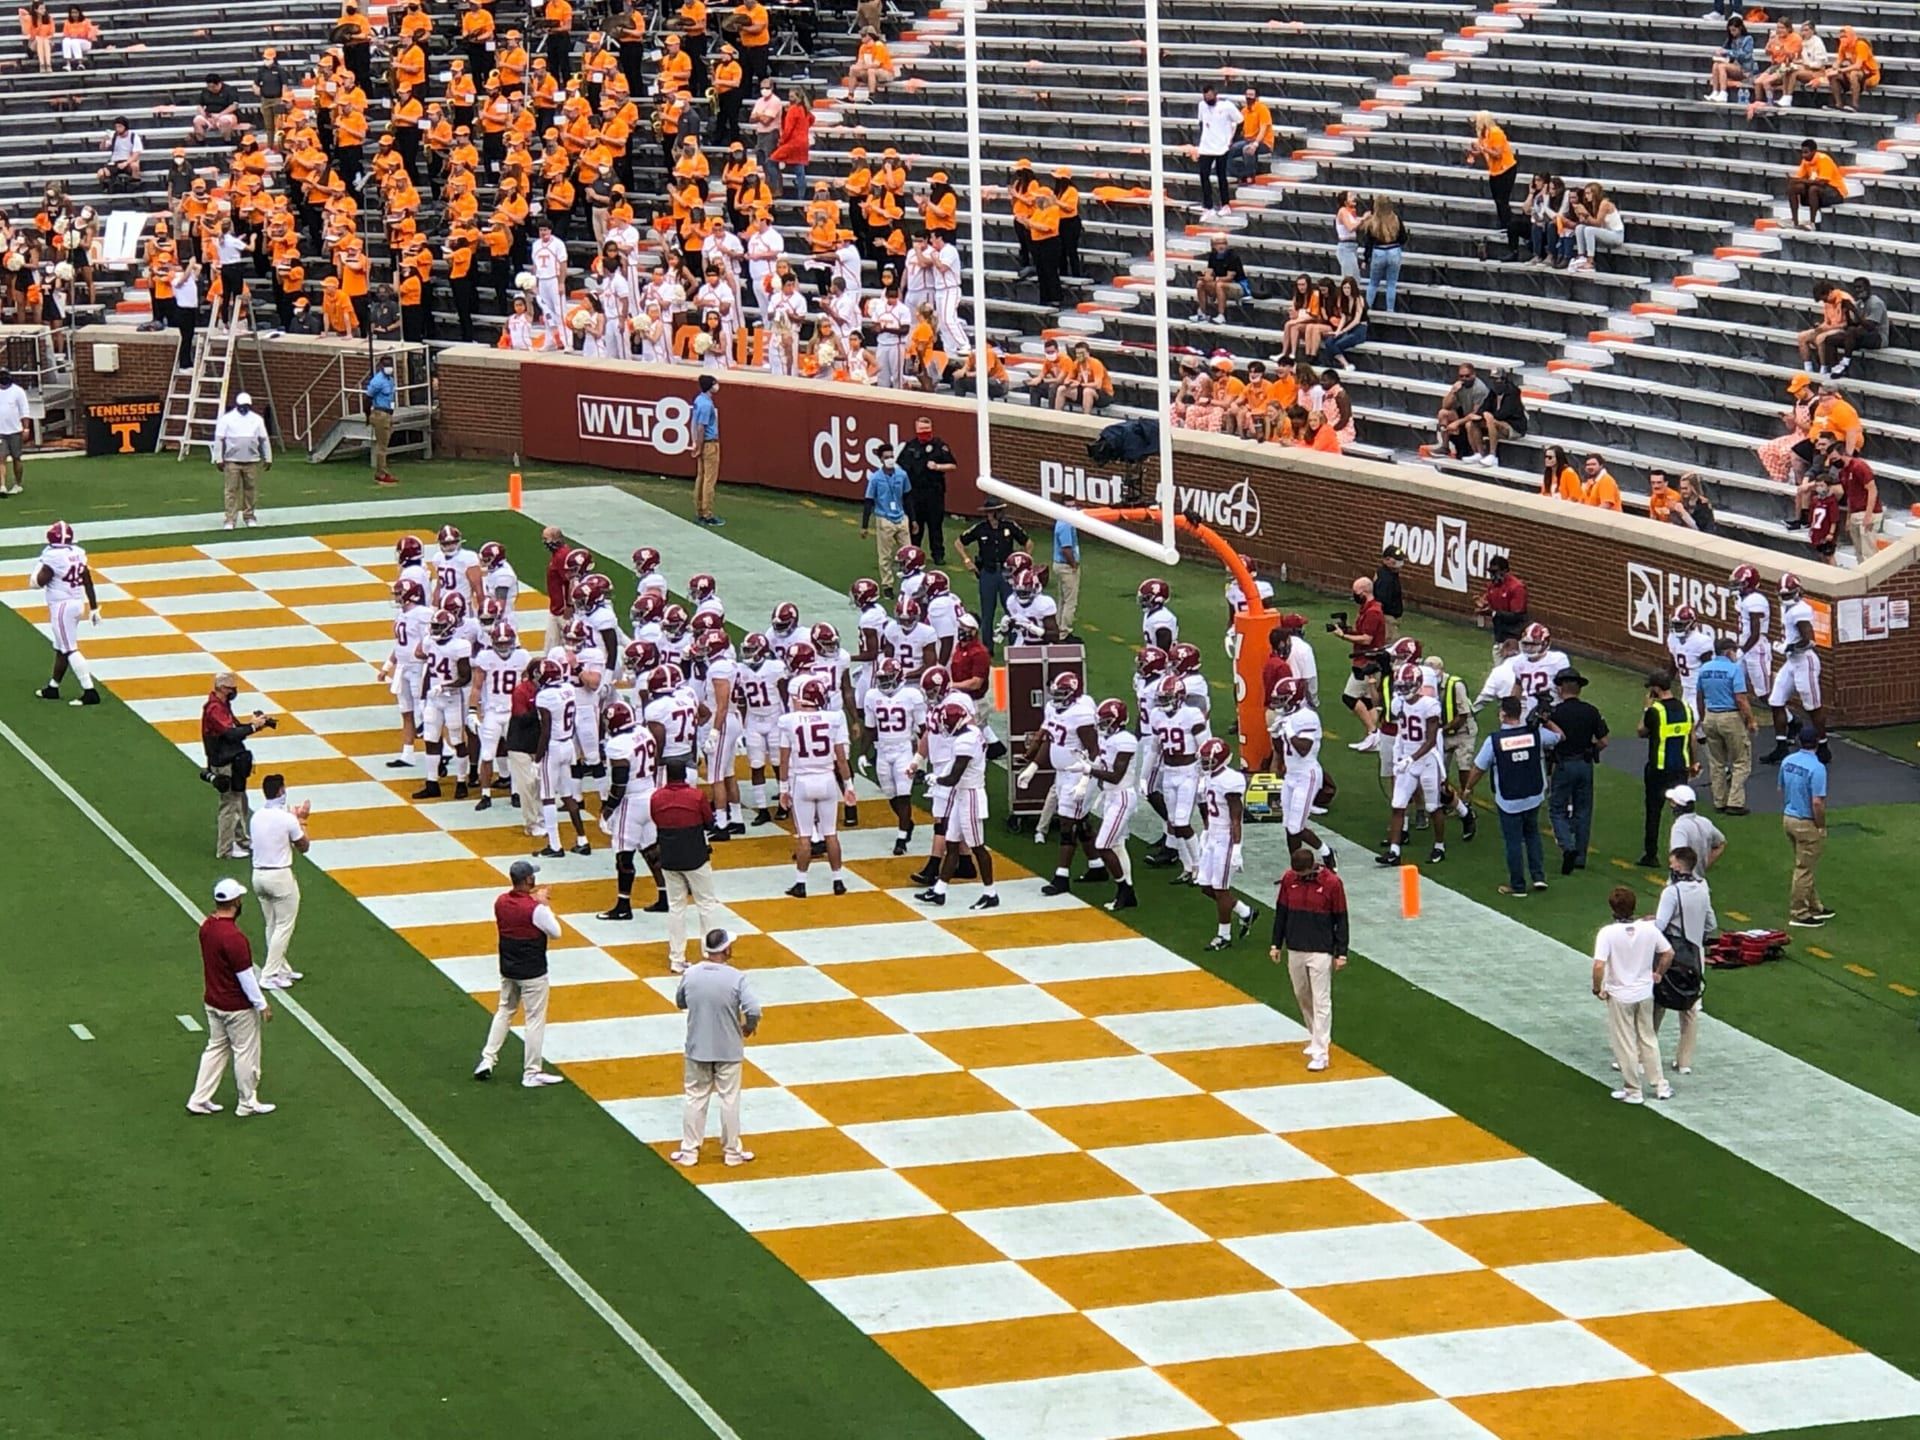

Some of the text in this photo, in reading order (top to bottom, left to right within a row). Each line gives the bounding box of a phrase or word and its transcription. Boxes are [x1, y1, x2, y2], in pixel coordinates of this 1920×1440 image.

[538, 255, 550, 268] T
[88, 402, 160, 417] TENNESSEE
[111, 422, 141, 453] T
[582, 396, 691, 455] WVLT 8
[1382, 521, 1436, 566] FOOD
[1668, 573, 1730, 621] FIRST
[492, 670, 517, 695] 18
[745, 682, 771, 707] 21
[875, 707, 906, 733] 23
[795, 723, 831, 758] 15
